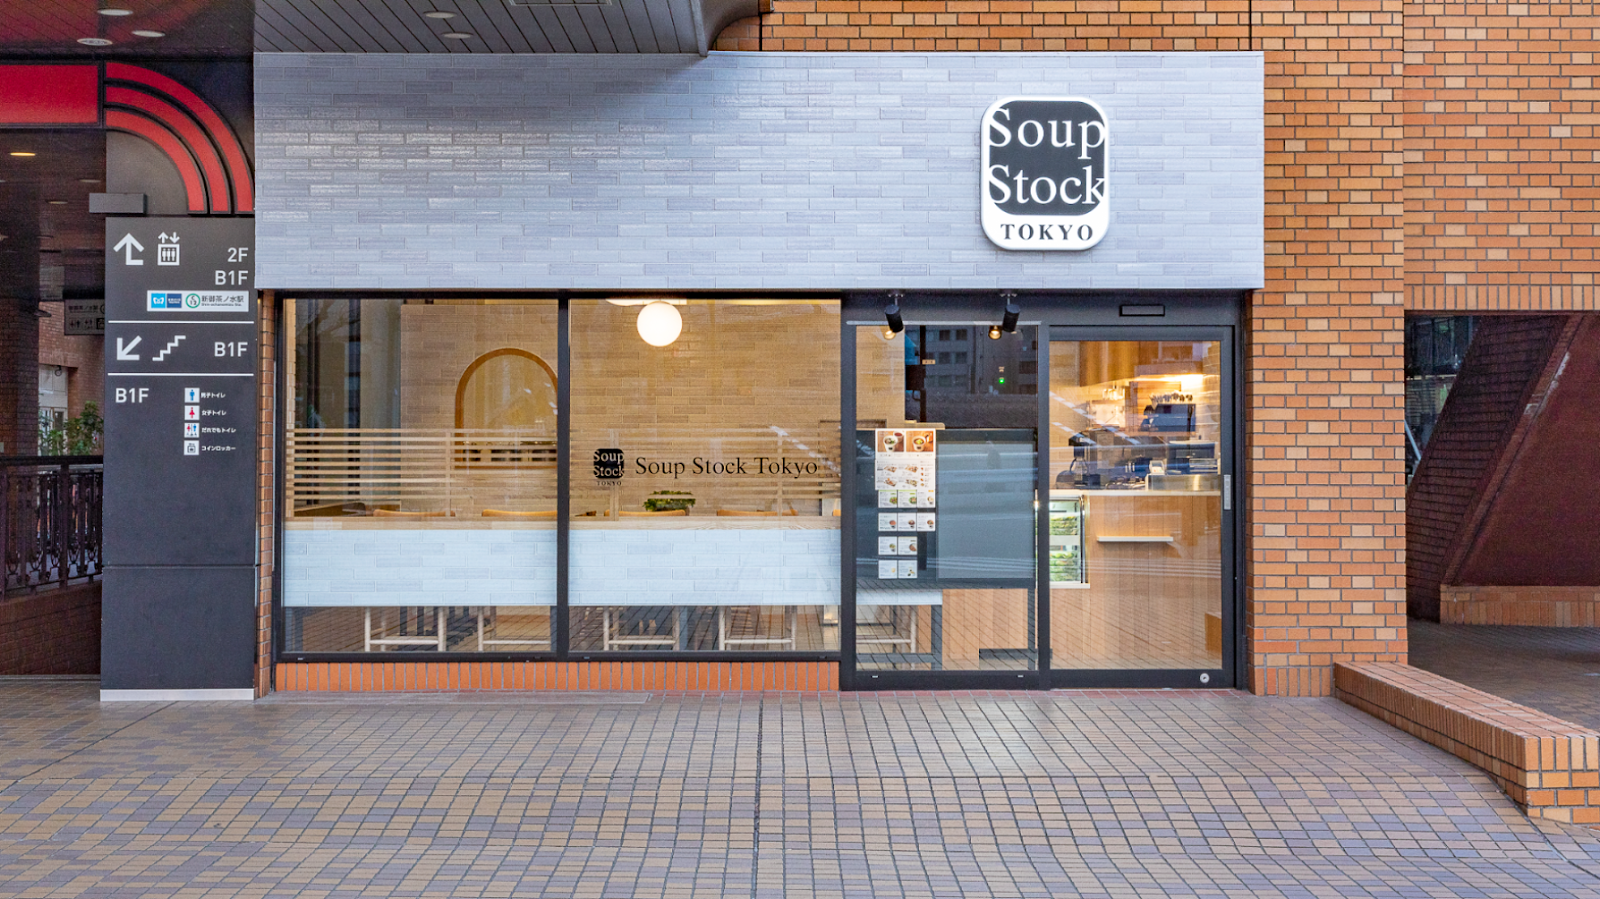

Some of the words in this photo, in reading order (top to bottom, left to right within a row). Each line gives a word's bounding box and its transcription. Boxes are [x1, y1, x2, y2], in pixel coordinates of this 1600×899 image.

[988, 107, 1105, 160] Soup
[988, 164, 1105, 205] Stock
[1000, 223, 1094, 241] TOKYO
[227, 247, 249, 263] 2F
[215, 270, 249, 286] B1F
[201, 295, 245, 303] 新御茶ノ水駅
[214, 342, 248, 357] B1F
[115, 388, 150, 403] B1F
[200, 391, 226, 399] 男子トイレ
[593, 450, 625, 465] Soup
[593, 465, 625, 477] Stock
[635, 457, 686, 479] Soup
[692, 456, 747, 475] Stock
[753, 457, 818, 479] Tokyo
